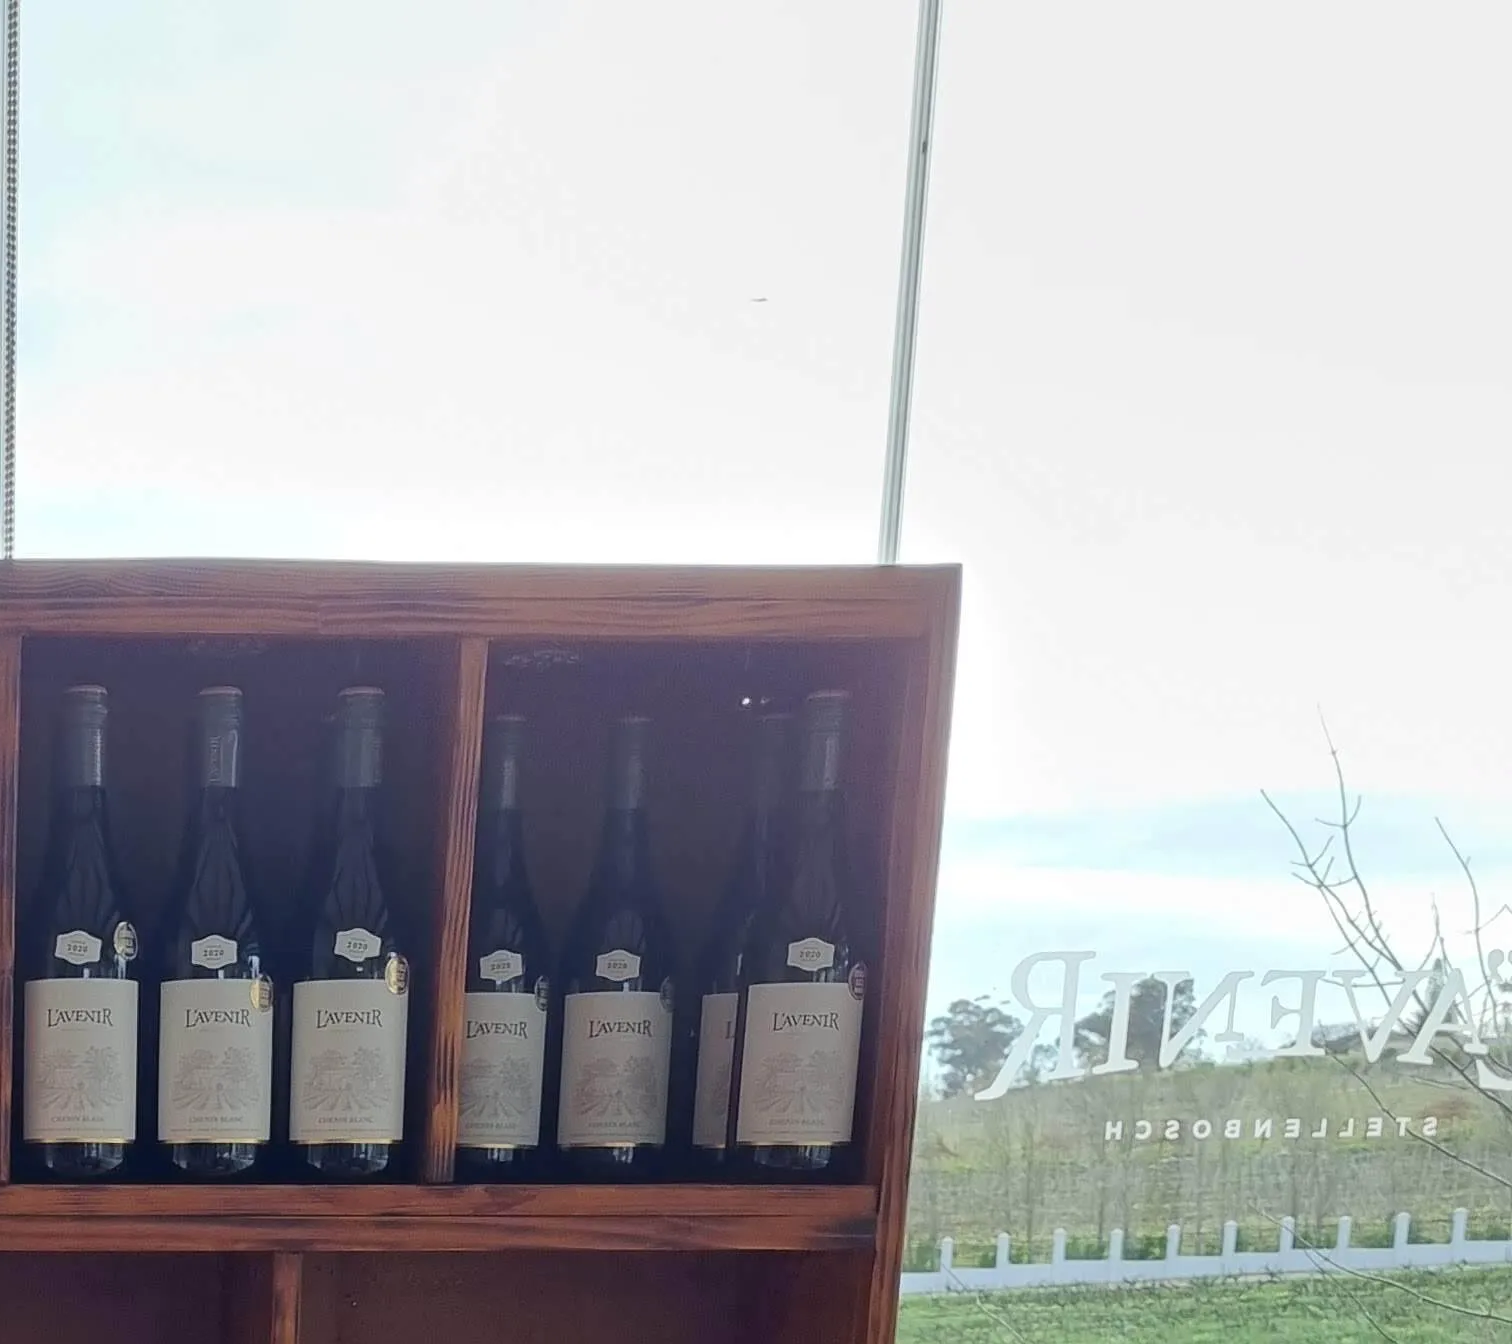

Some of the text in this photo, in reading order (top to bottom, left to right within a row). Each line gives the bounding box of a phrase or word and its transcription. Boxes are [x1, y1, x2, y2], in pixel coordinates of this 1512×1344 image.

[48, 1008, 113, 1027] L'AVENIR
[186, 1009, 252, 1028] L'AVENIR
[316, 1009, 383, 1029] L'AVENIR
[773, 1012, 839, 1031] L'AVENIR
[466, 1020, 528, 1039] L'AVENIR
[588, 1020, 653, 1038] L'AVENIR
